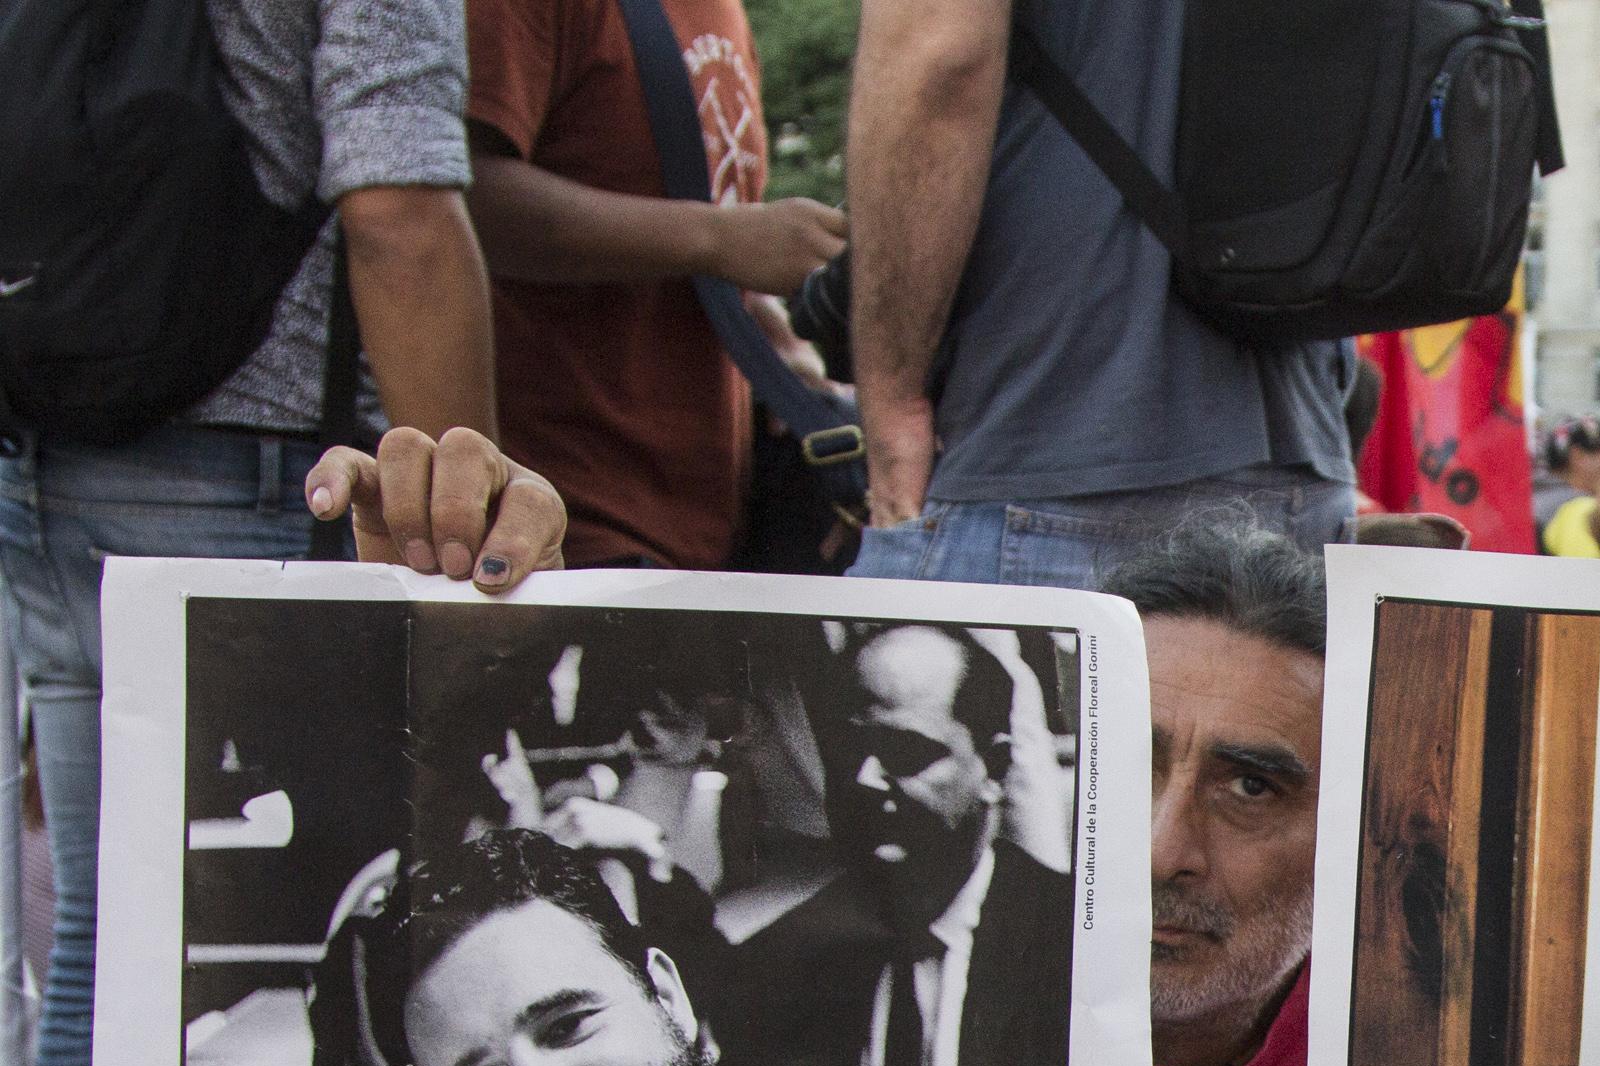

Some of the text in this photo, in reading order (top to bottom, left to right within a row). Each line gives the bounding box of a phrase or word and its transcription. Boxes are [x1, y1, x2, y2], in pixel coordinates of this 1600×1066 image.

[1083, 635, 1100, 931] Centro Cultural de la Cooperación Floreal Gorini
